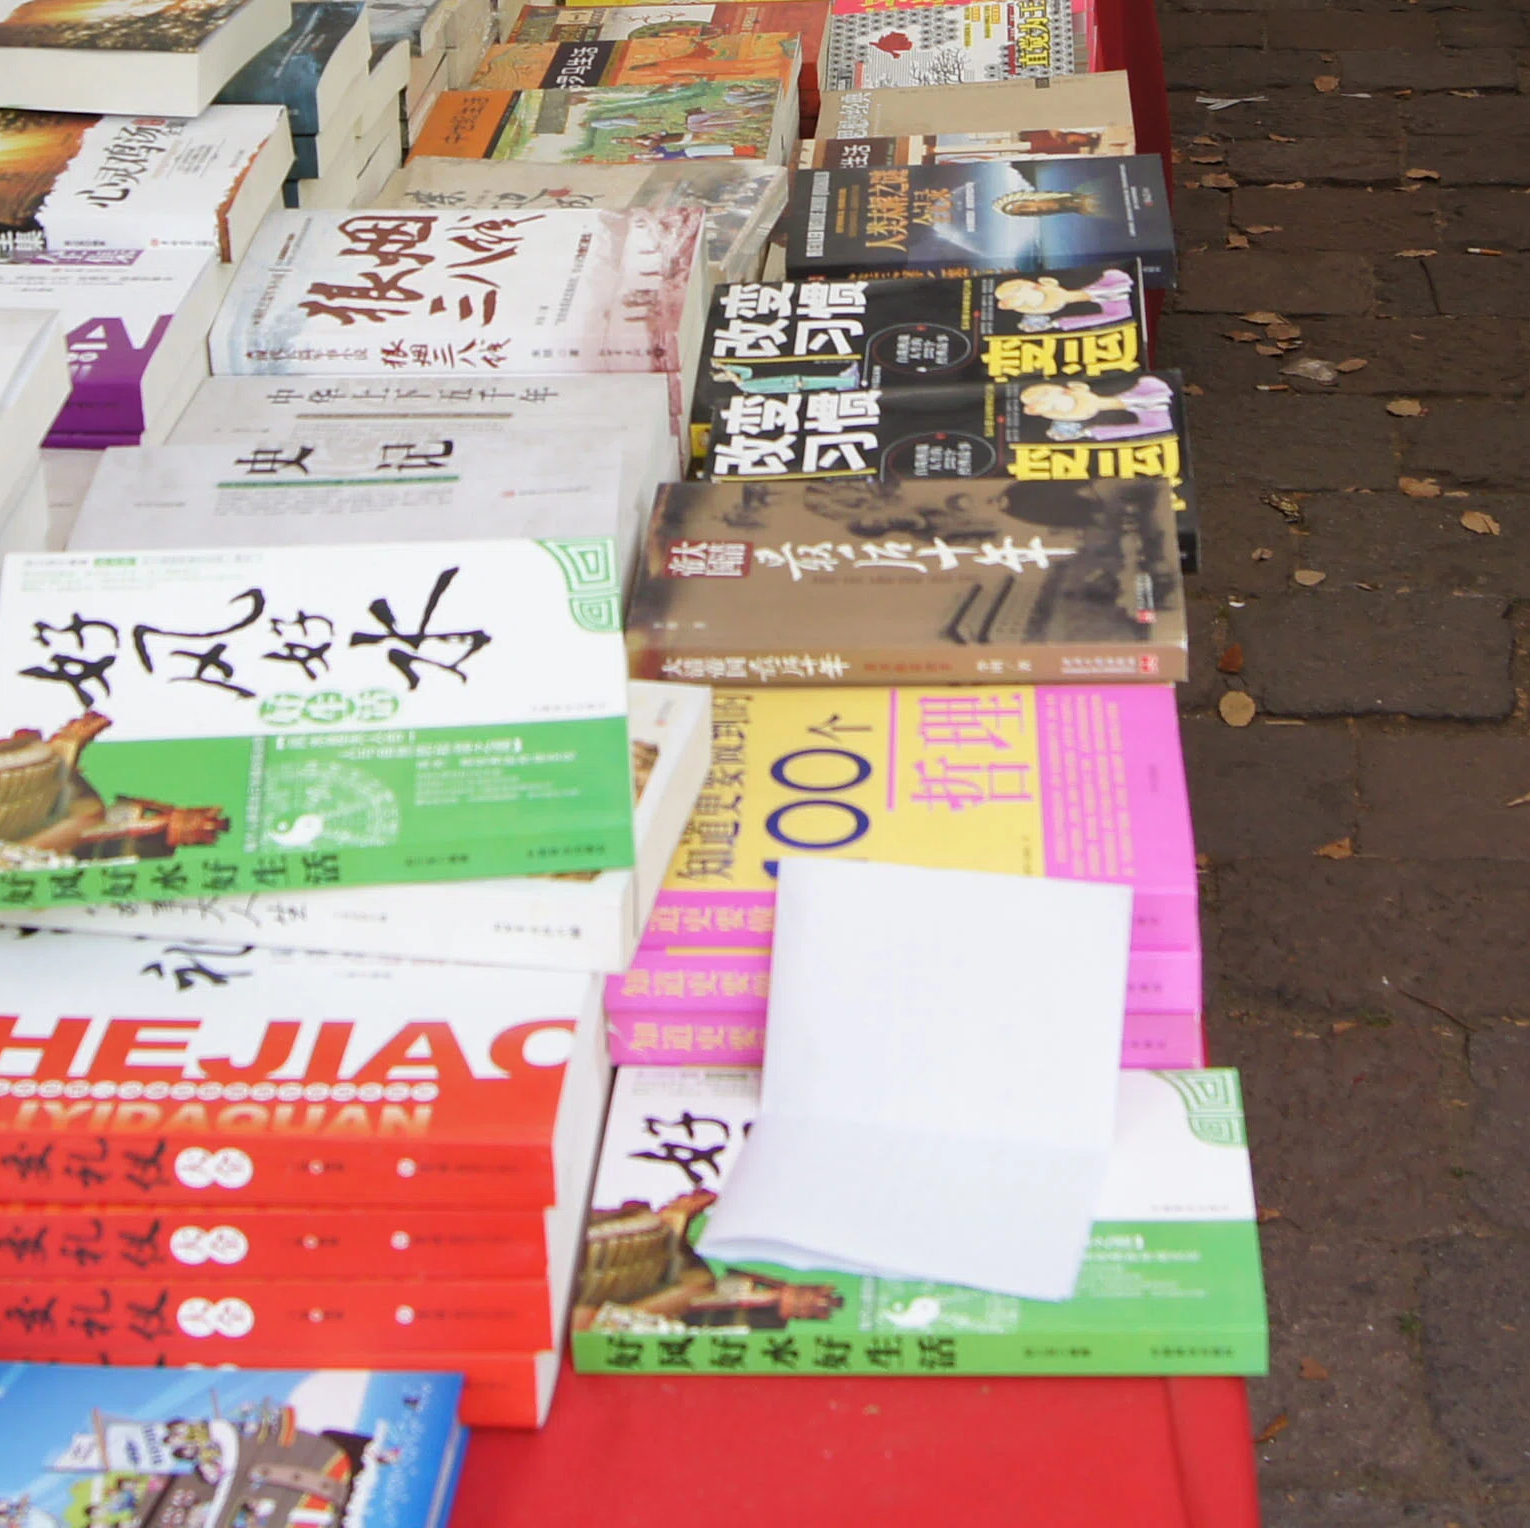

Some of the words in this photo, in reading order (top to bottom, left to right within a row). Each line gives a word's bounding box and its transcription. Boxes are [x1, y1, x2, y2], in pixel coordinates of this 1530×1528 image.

[74, 117, 164, 210] 心灵鸡汤
[865, 168, 910, 254] 人类未解之谜
[299, 213, 438, 326] 狼烟
[268, 385, 560, 407] 中华上下五千年
[234, 438, 456, 477] 史记
[752, 535, 1078, 582] 最后十年
[17, 564, 495, 712] 好风好水
[258, 686, 403, 727] 好生活
[909, 691, 1035, 813] 哲理
[604, 1333, 961, 1372] 好风好水好生活
